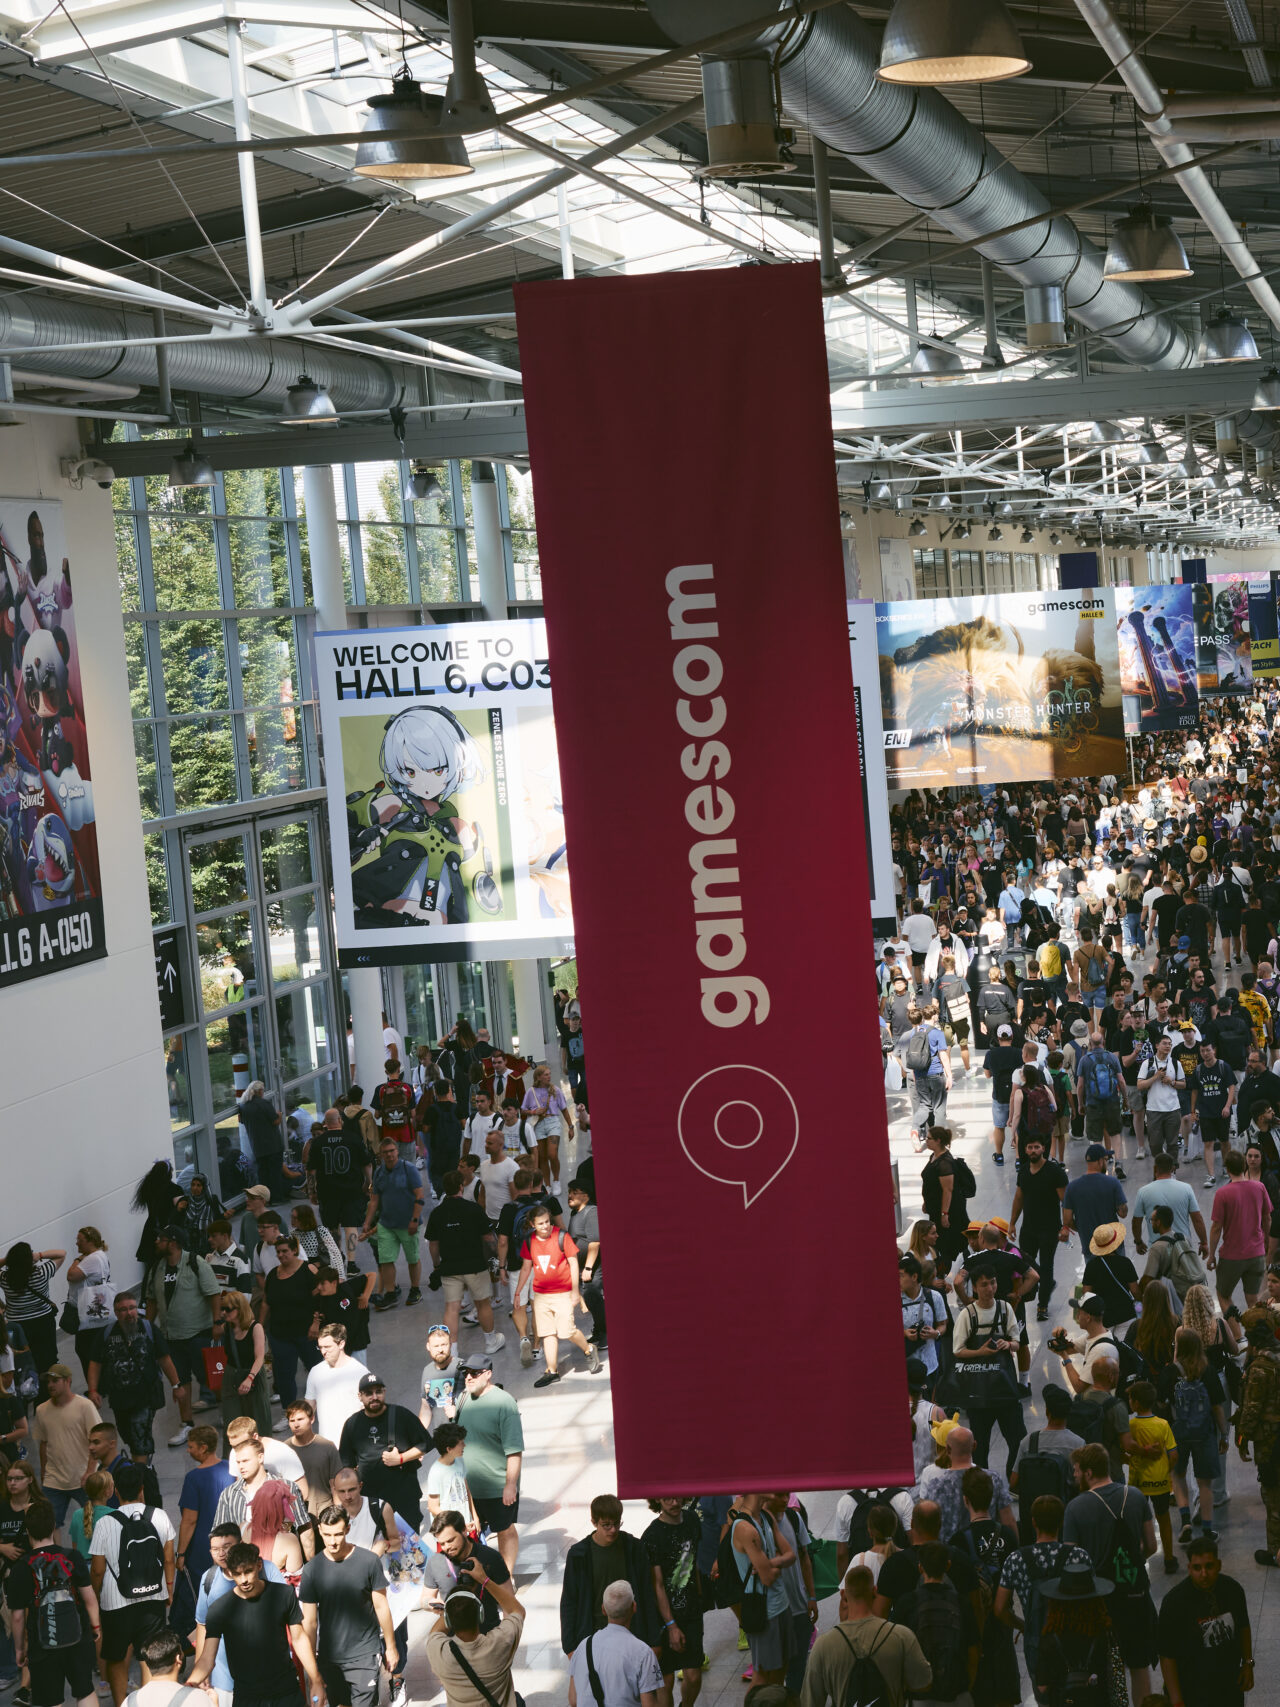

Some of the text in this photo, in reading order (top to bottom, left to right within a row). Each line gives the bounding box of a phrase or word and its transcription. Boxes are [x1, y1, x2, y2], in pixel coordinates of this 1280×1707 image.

[1027, 599, 1105, 616] gamescom
[333, 637, 514, 667] WELCOME TO
[1200, 634, 1231, 646] PASS
[335, 666, 435, 700] HALL
[965, 702, 1093, 721] MONSTER HUNTER
[492, 711, 507, 806] ZENLESS ZONE ZERO
[18, 791, 45, 811] RIVALS
[664, 563, 771, 1028] gamescom
[39, 911, 94, 962] A-050
[321, 1145, 351, 1176] 10
[132, 1583, 160, 1594] adidas
